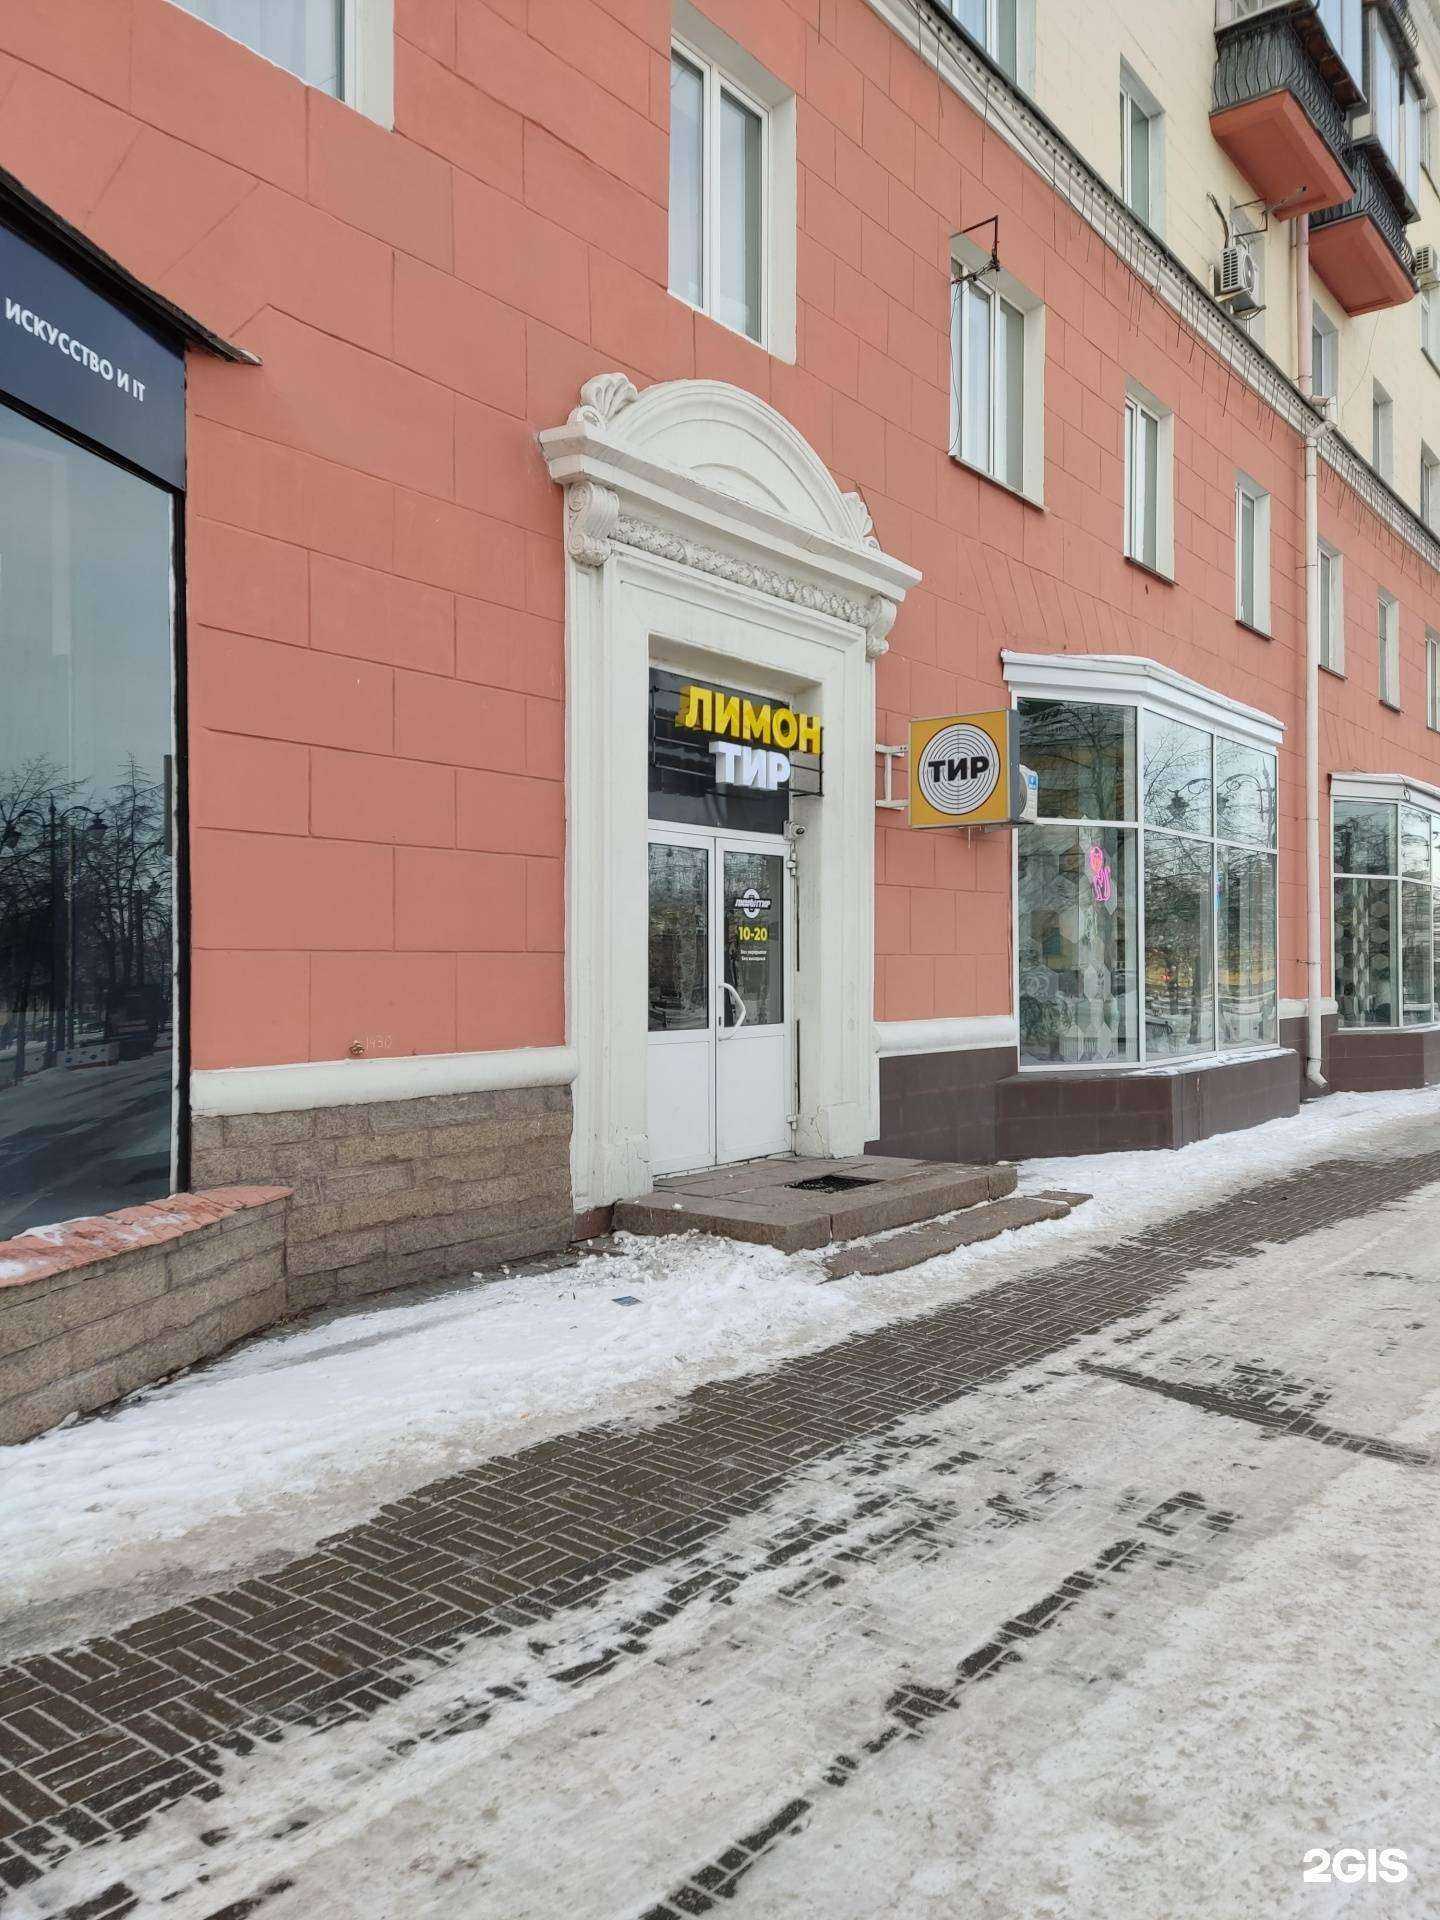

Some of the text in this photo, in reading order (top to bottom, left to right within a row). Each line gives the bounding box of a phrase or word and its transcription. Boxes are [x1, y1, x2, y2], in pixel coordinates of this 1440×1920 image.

[5, 297, 114, 381] ИСКУССТВО
[116, 368, 129, 393] И
[679, 685, 822, 754] ЛИМОН
[709, 740, 791, 790] ТИР
[927, 755, 990, 784] ТИР
[738, 926, 768, 941] 10-20
